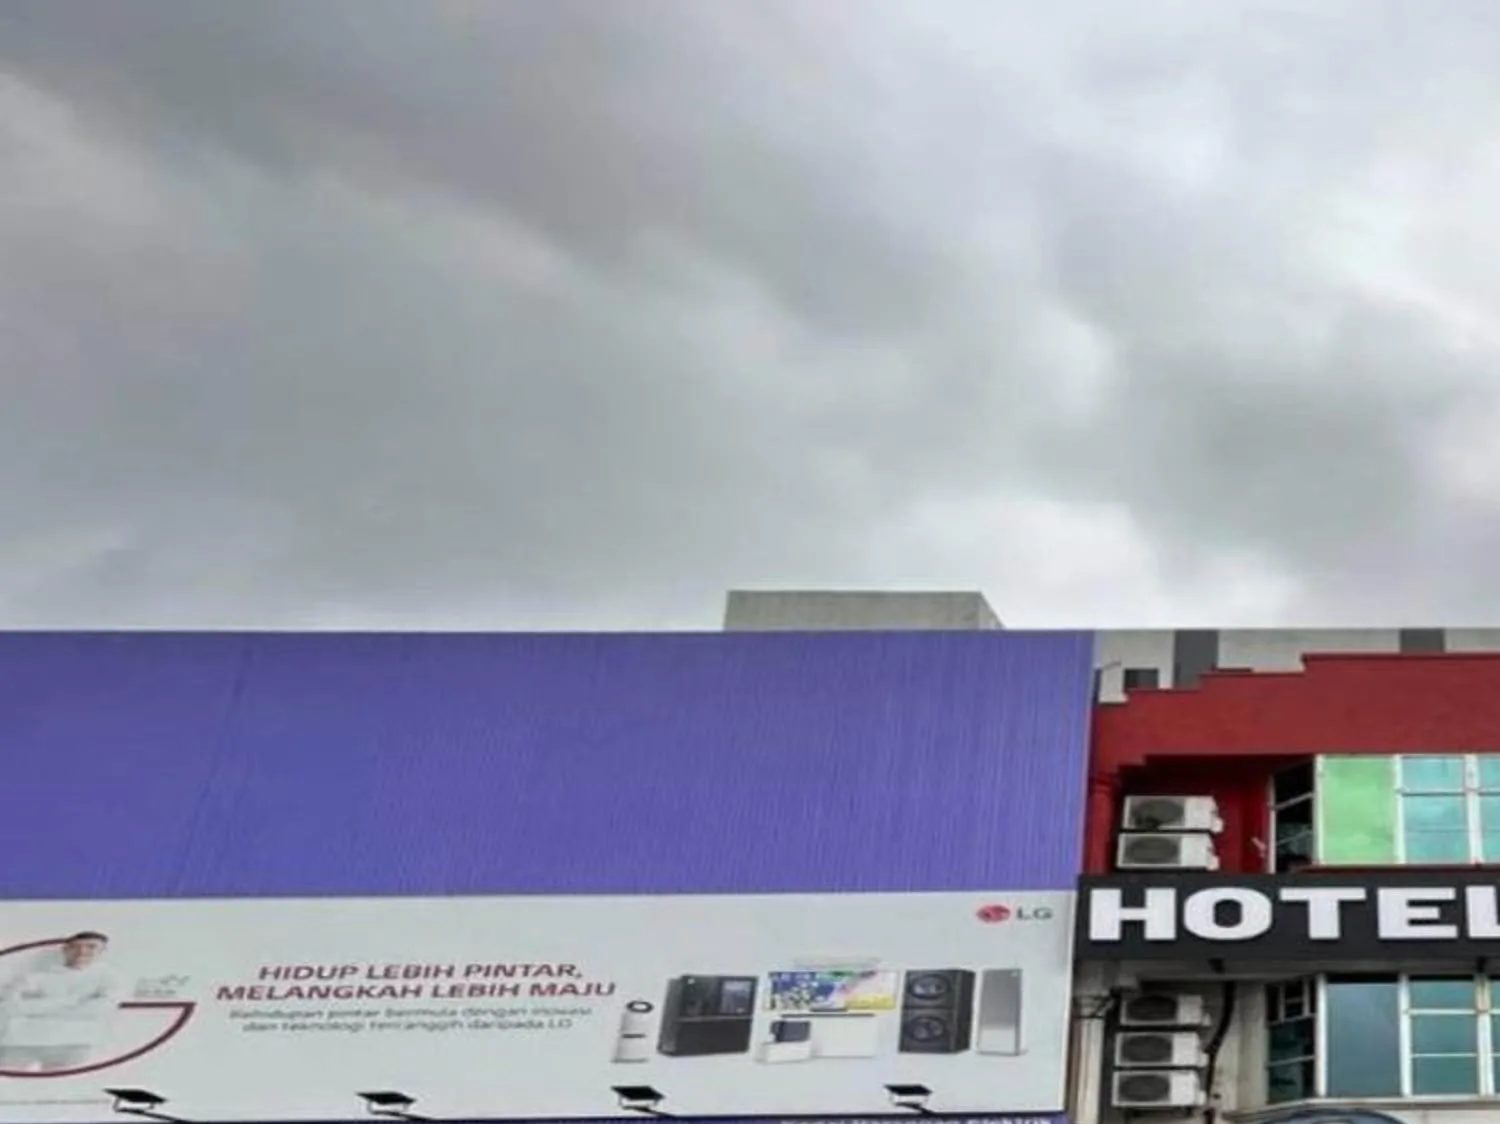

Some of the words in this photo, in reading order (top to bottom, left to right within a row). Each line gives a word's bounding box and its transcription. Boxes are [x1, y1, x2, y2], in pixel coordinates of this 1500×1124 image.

[1016, 905, 1053, 920] LG
[258, 965, 358, 980] HIDUP
[366, 964, 454, 979] LEBIH
[464, 963, 583, 979] PINTAR,
[216, 984, 423, 1000] MELANGKAH
[432, 983, 520, 998] LEBIH
[529, 982, 616, 997] MAJU
